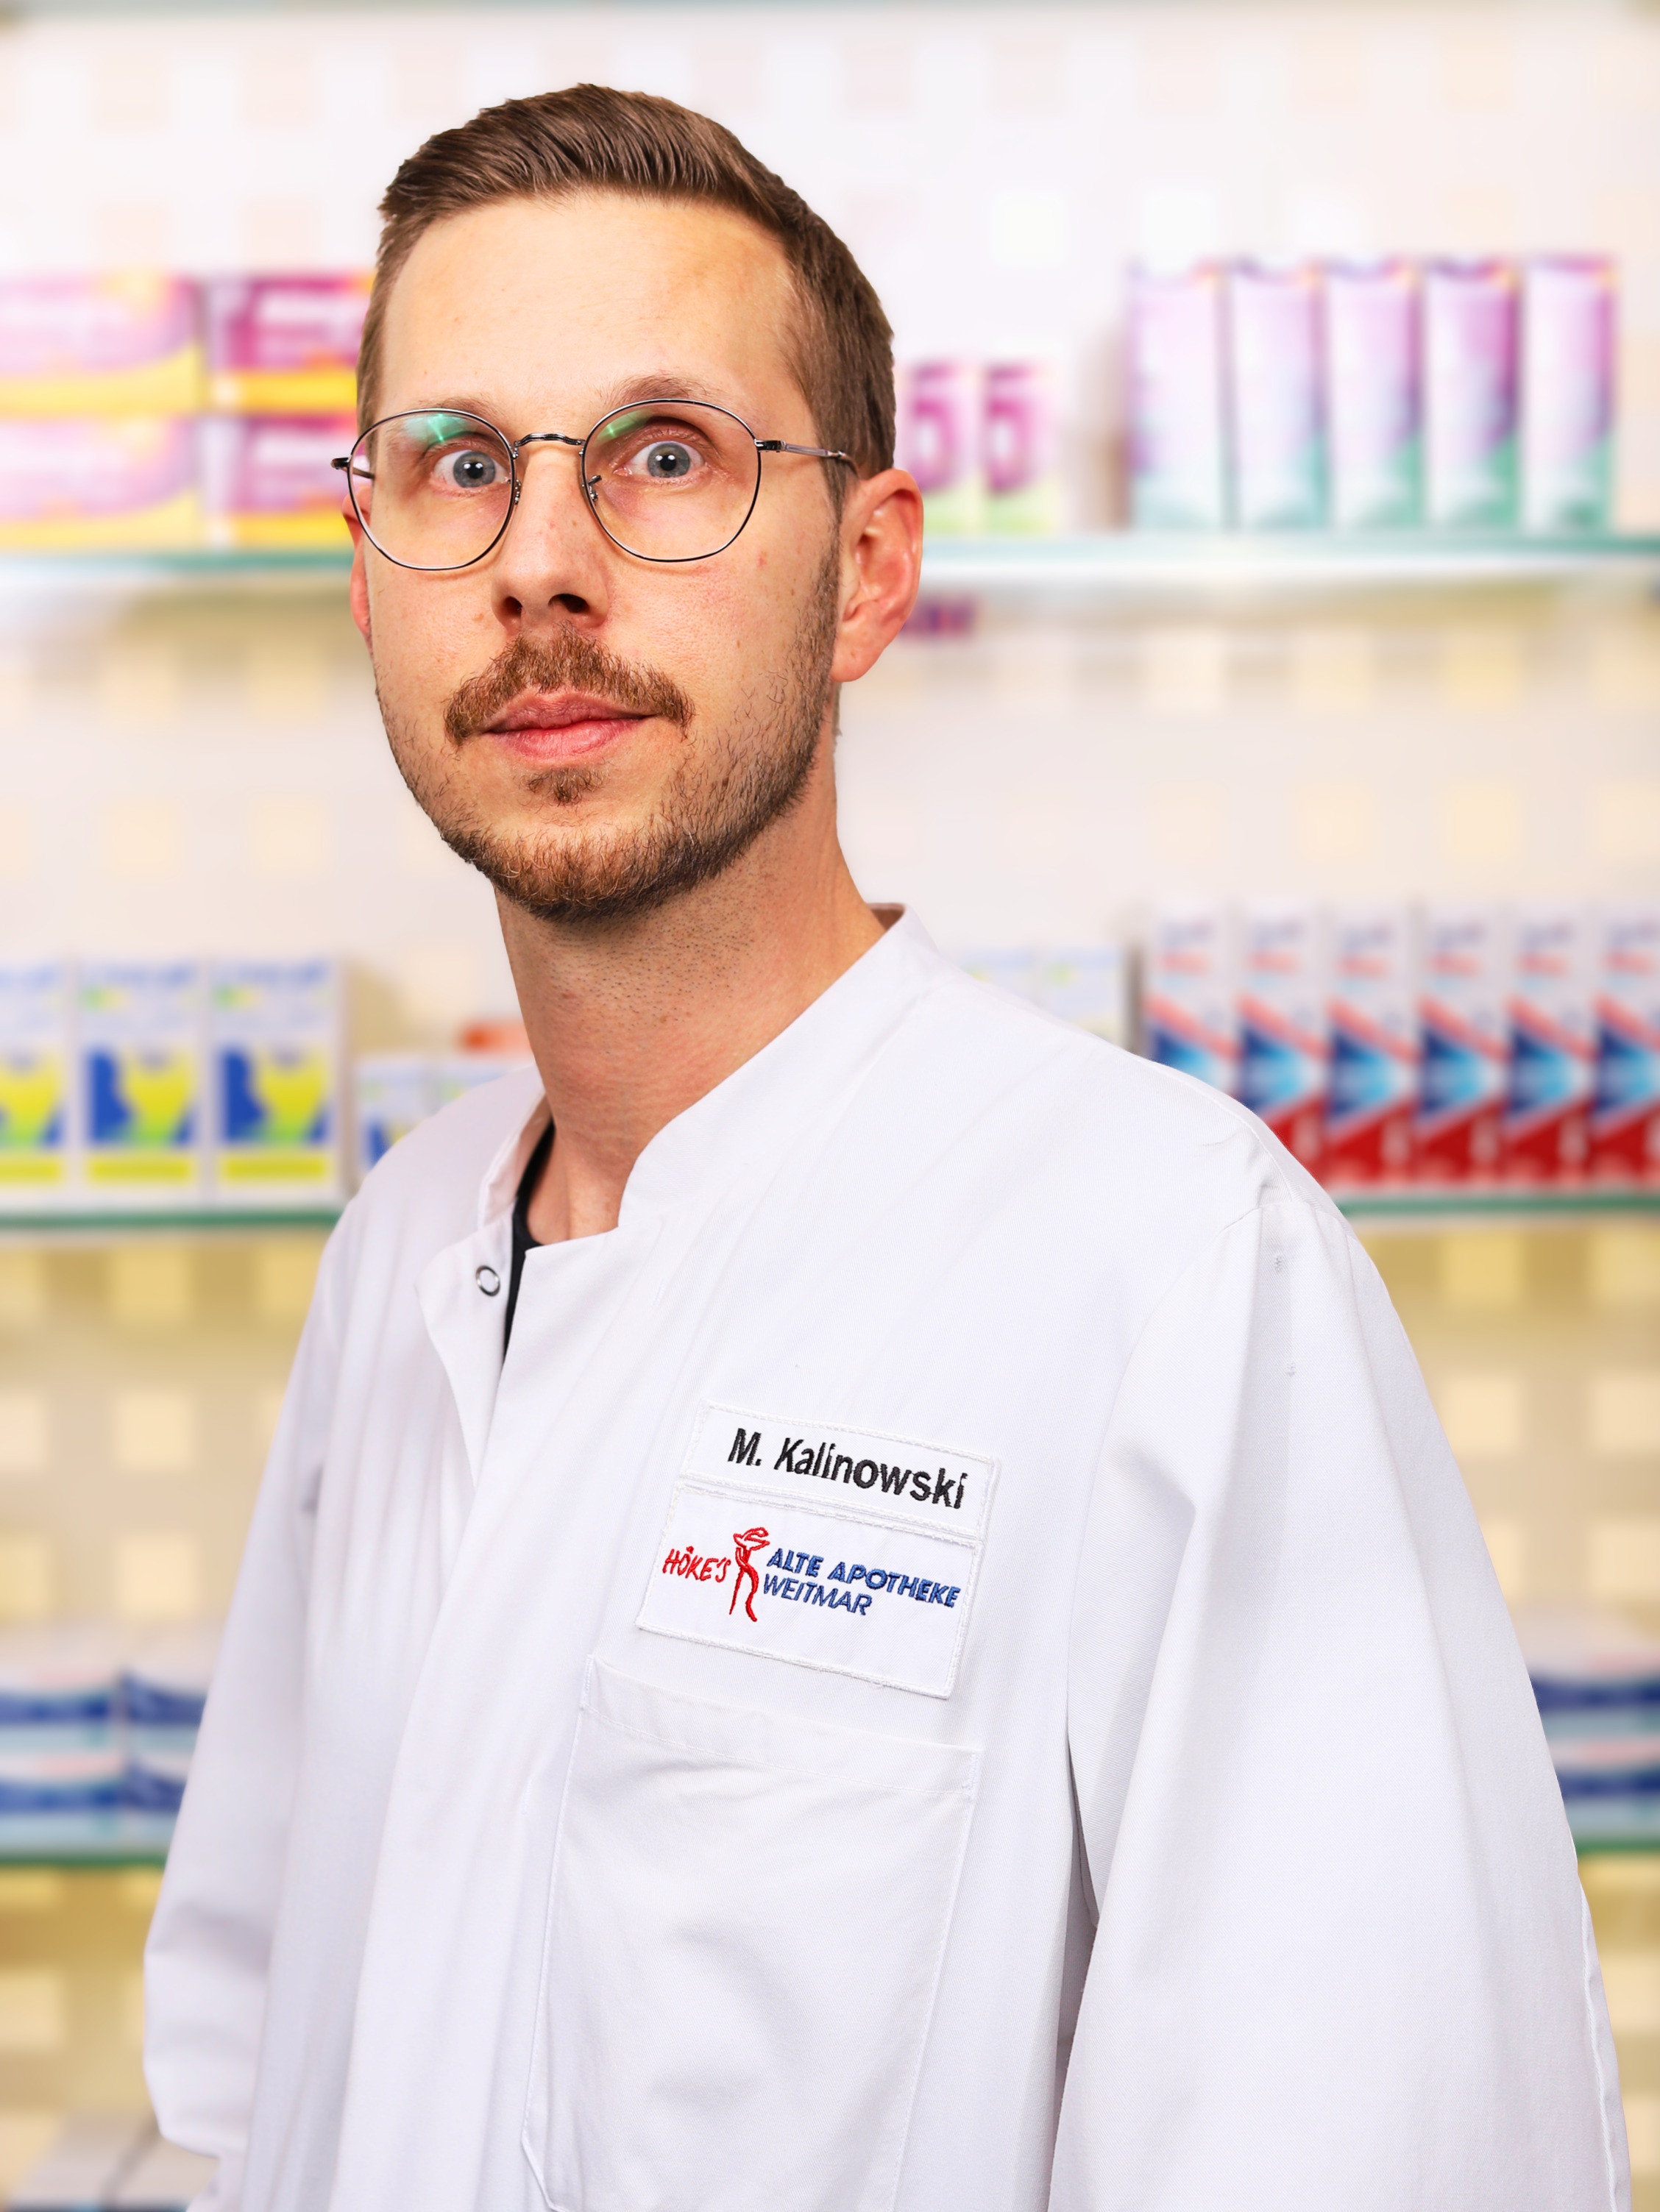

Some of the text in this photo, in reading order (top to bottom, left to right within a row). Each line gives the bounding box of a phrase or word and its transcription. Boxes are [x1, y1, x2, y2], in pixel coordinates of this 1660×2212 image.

[728, 1429, 968, 1509] M. Kalinowski
[763, 1574, 873, 1615] WEITMAR
[767, 1548, 961, 1608] ALTE APOTHEKE
